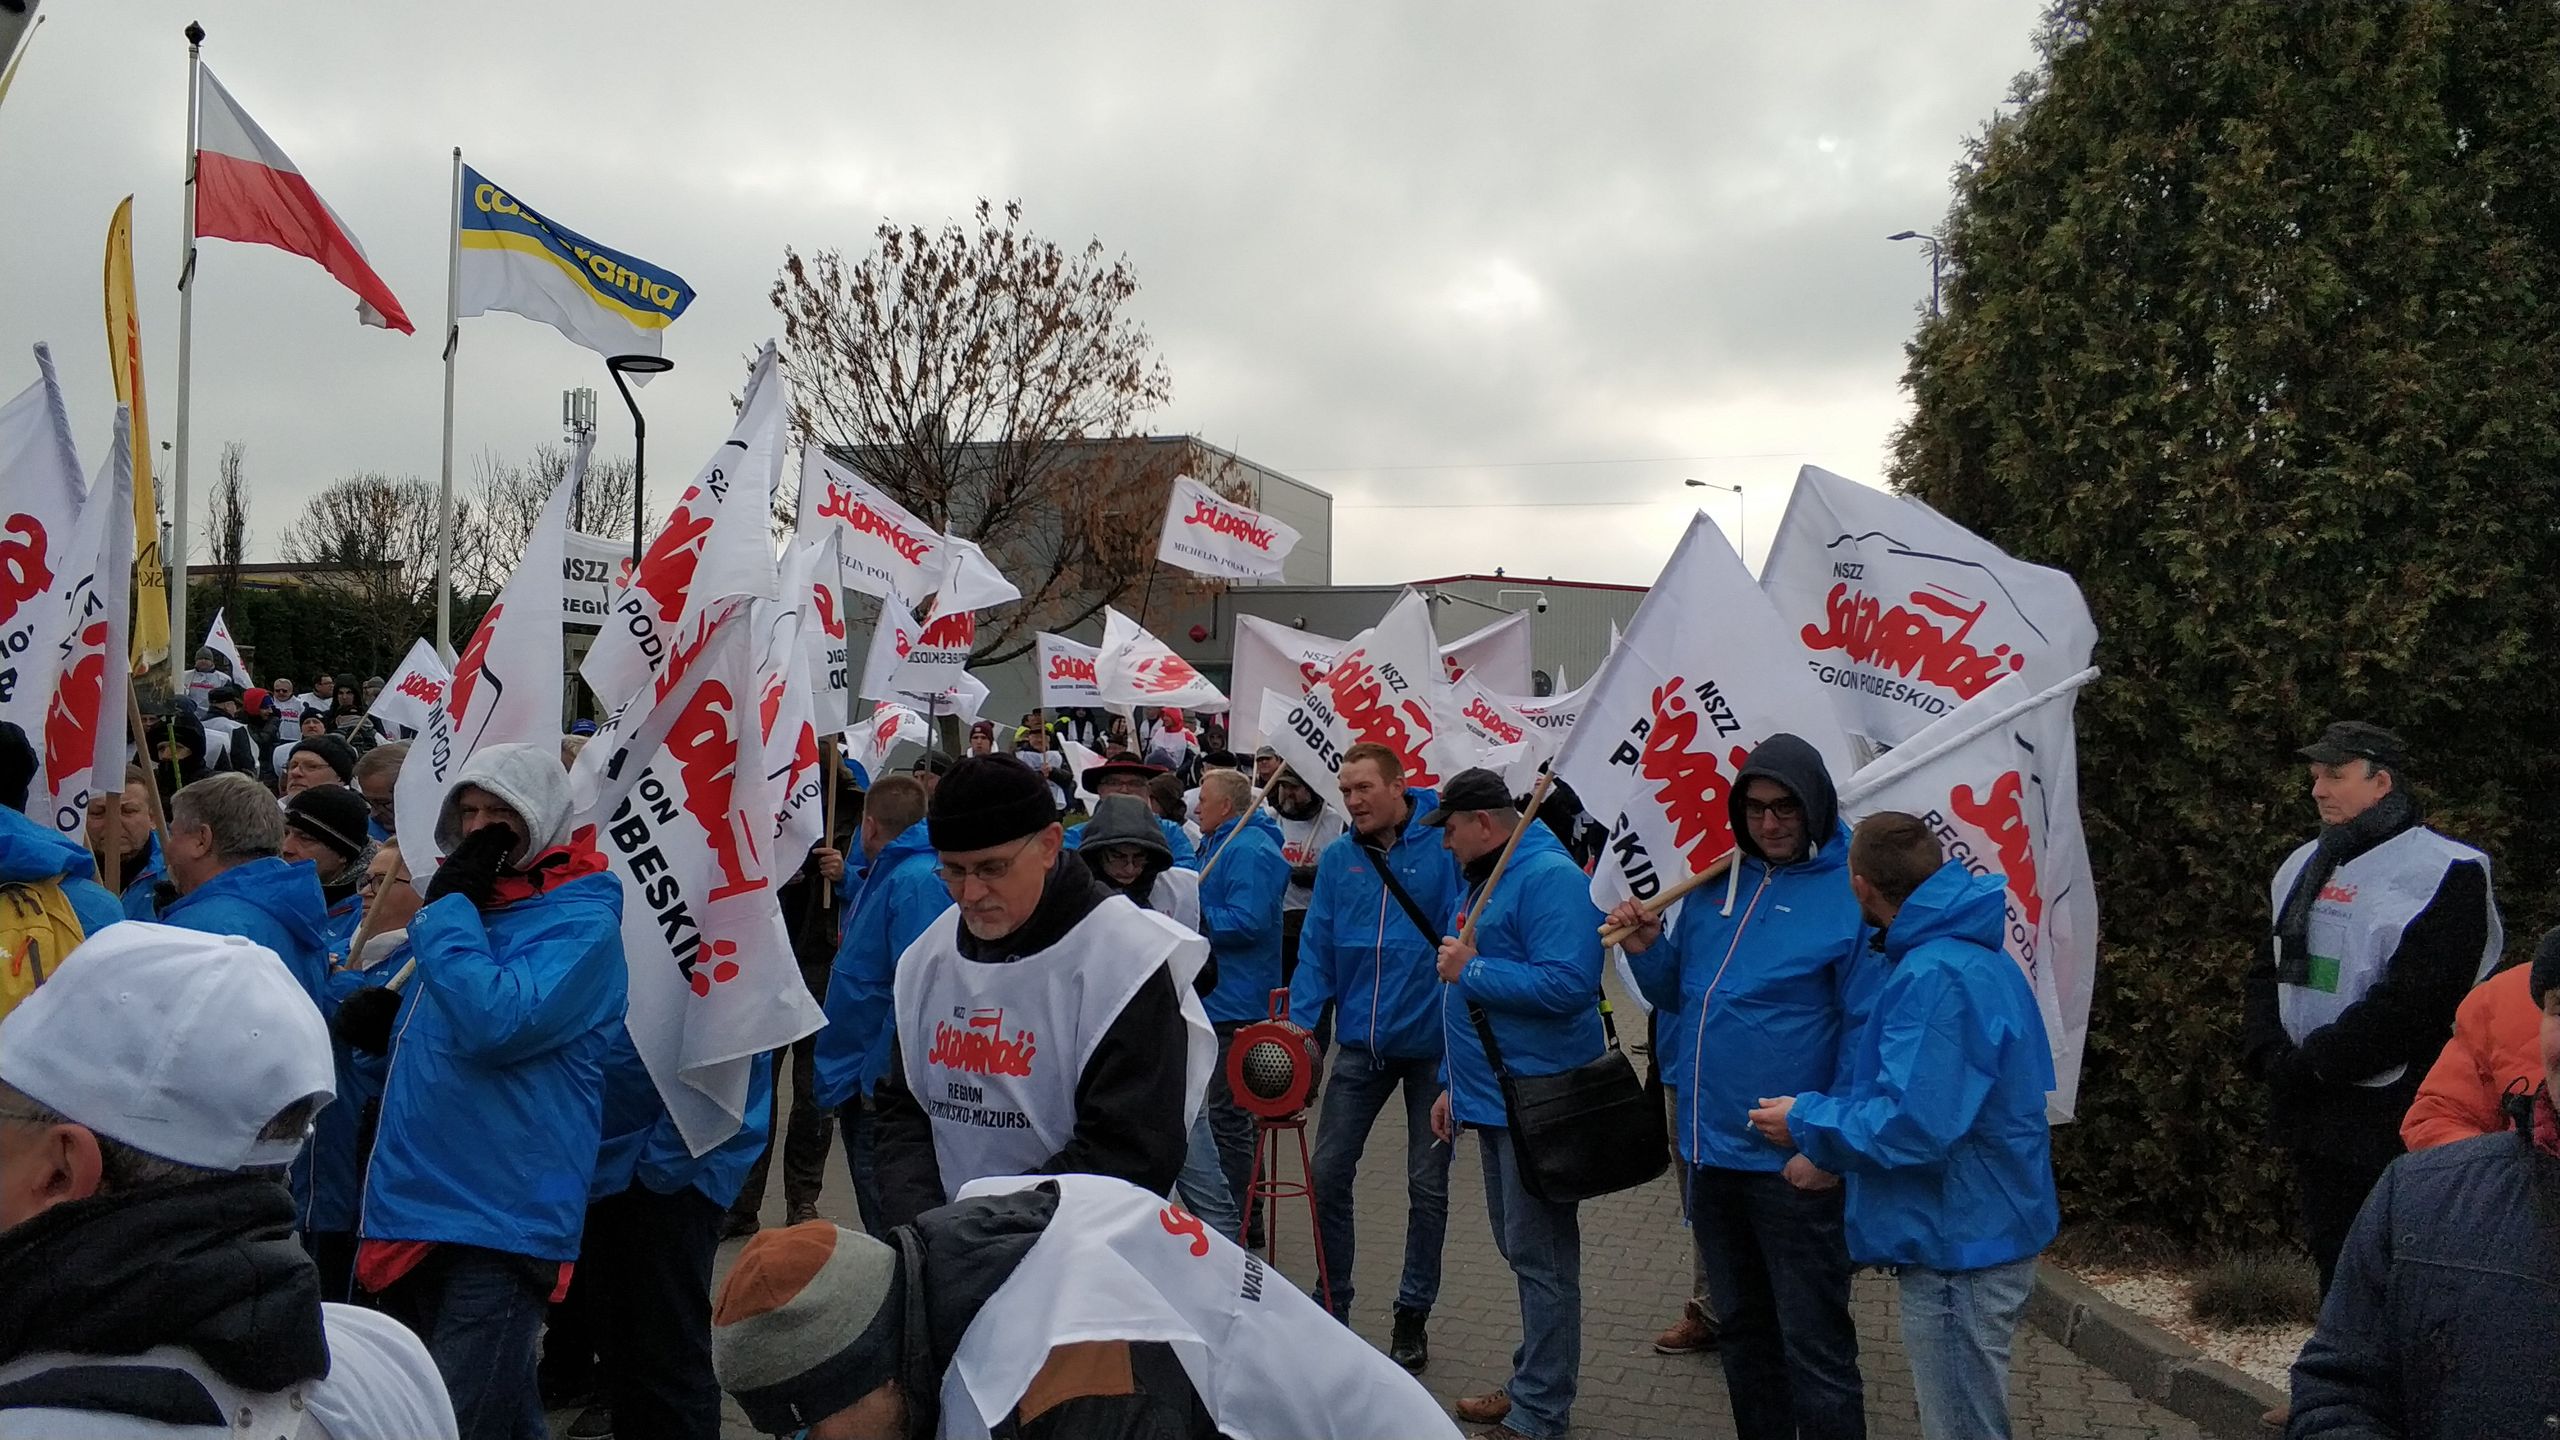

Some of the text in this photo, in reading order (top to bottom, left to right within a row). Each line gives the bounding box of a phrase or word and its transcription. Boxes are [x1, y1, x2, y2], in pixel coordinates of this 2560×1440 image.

[1833, 561, 1864, 581] NSZZ
[1379, 662, 1409, 694] NSZZ
[1694, 680, 1741, 739] NSZZ
[948, 1082, 983, 1105] REGION
